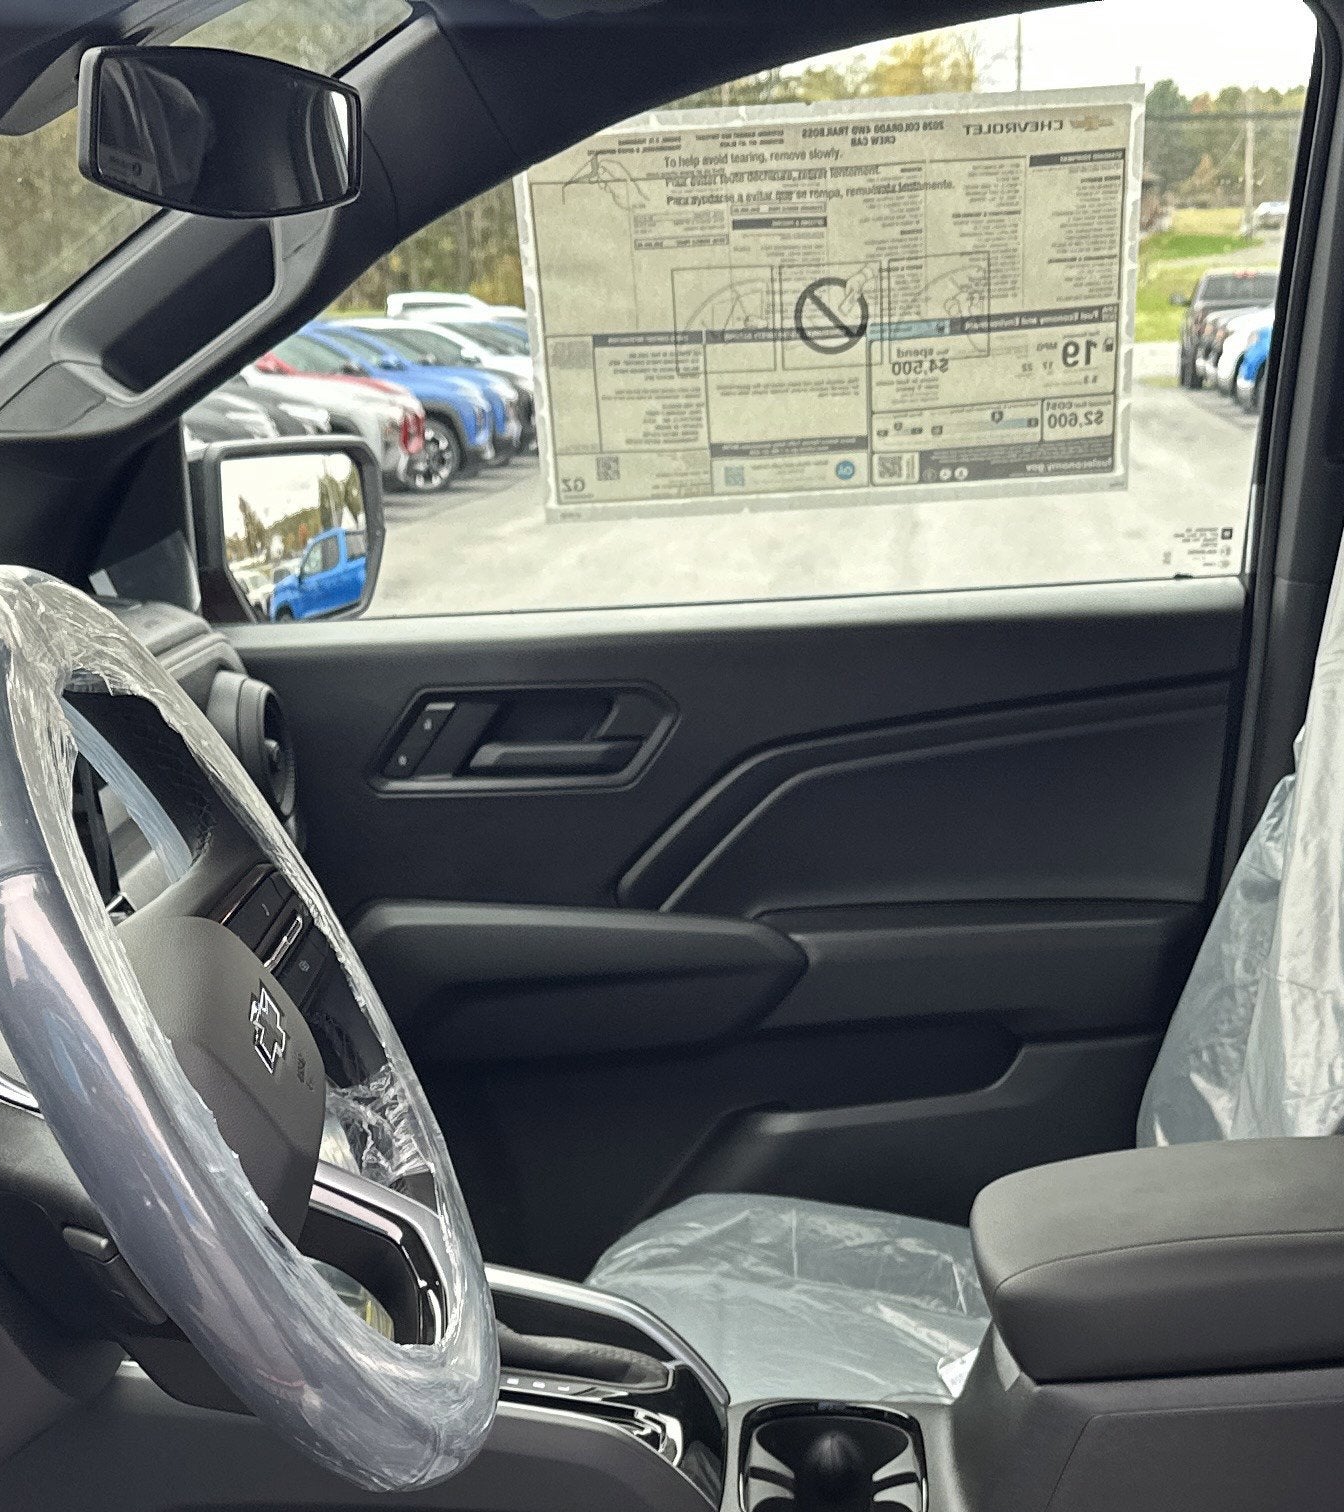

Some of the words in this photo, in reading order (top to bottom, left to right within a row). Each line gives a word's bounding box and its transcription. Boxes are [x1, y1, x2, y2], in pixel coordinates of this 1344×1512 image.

[664, 156, 677, 168] To
[678, 154, 700, 168] help
[702, 153, 728, 165] avoid
[730, 152, 767, 164] tearing,
[770, 151, 806, 162] remove
[809, 147, 843, 161] slowly.
